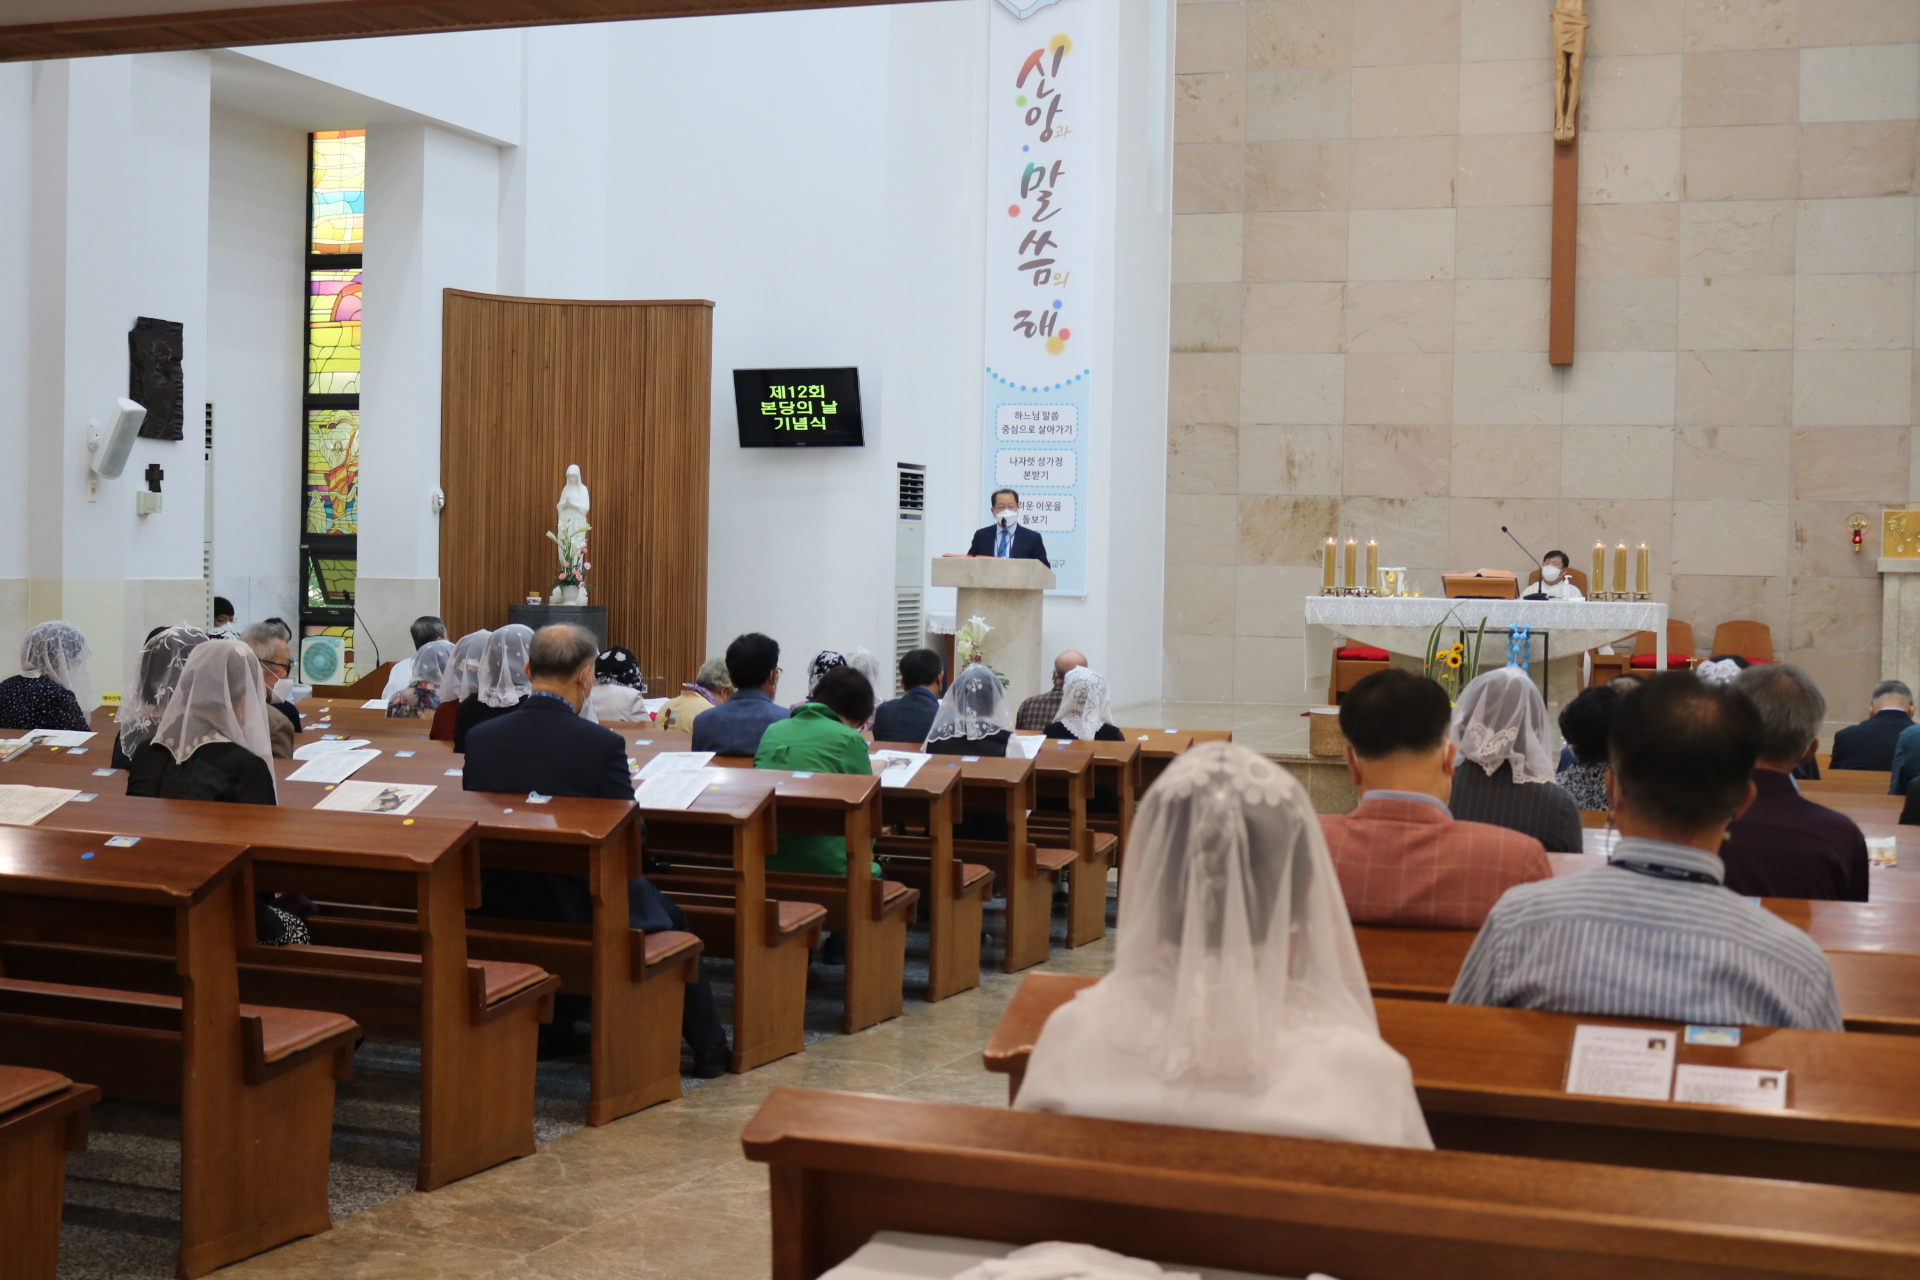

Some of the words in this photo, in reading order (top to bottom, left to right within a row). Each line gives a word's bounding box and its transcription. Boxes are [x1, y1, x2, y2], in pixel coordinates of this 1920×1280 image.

[769, 384, 826, 399] 제12회
[761, 400, 813, 415] 본당의
[821, 400, 838, 415] 날
[1014, 411, 1040, 421] 하느님
[1042, 411, 1060, 421] 말씀
[774, 416, 827, 431] 기념식
[1001, 424, 1036, 435] 중심으로
[1038, 424, 1073, 435] 살아가기
[1009, 456, 1036, 467] 나자렛
[1038, 456, 1063, 467] 성가정
[1023, 470, 1049, 481] 본받기
[1036, 501, 1062, 512] 이웃을
[1022, 515, 1048, 525] 돌보기
